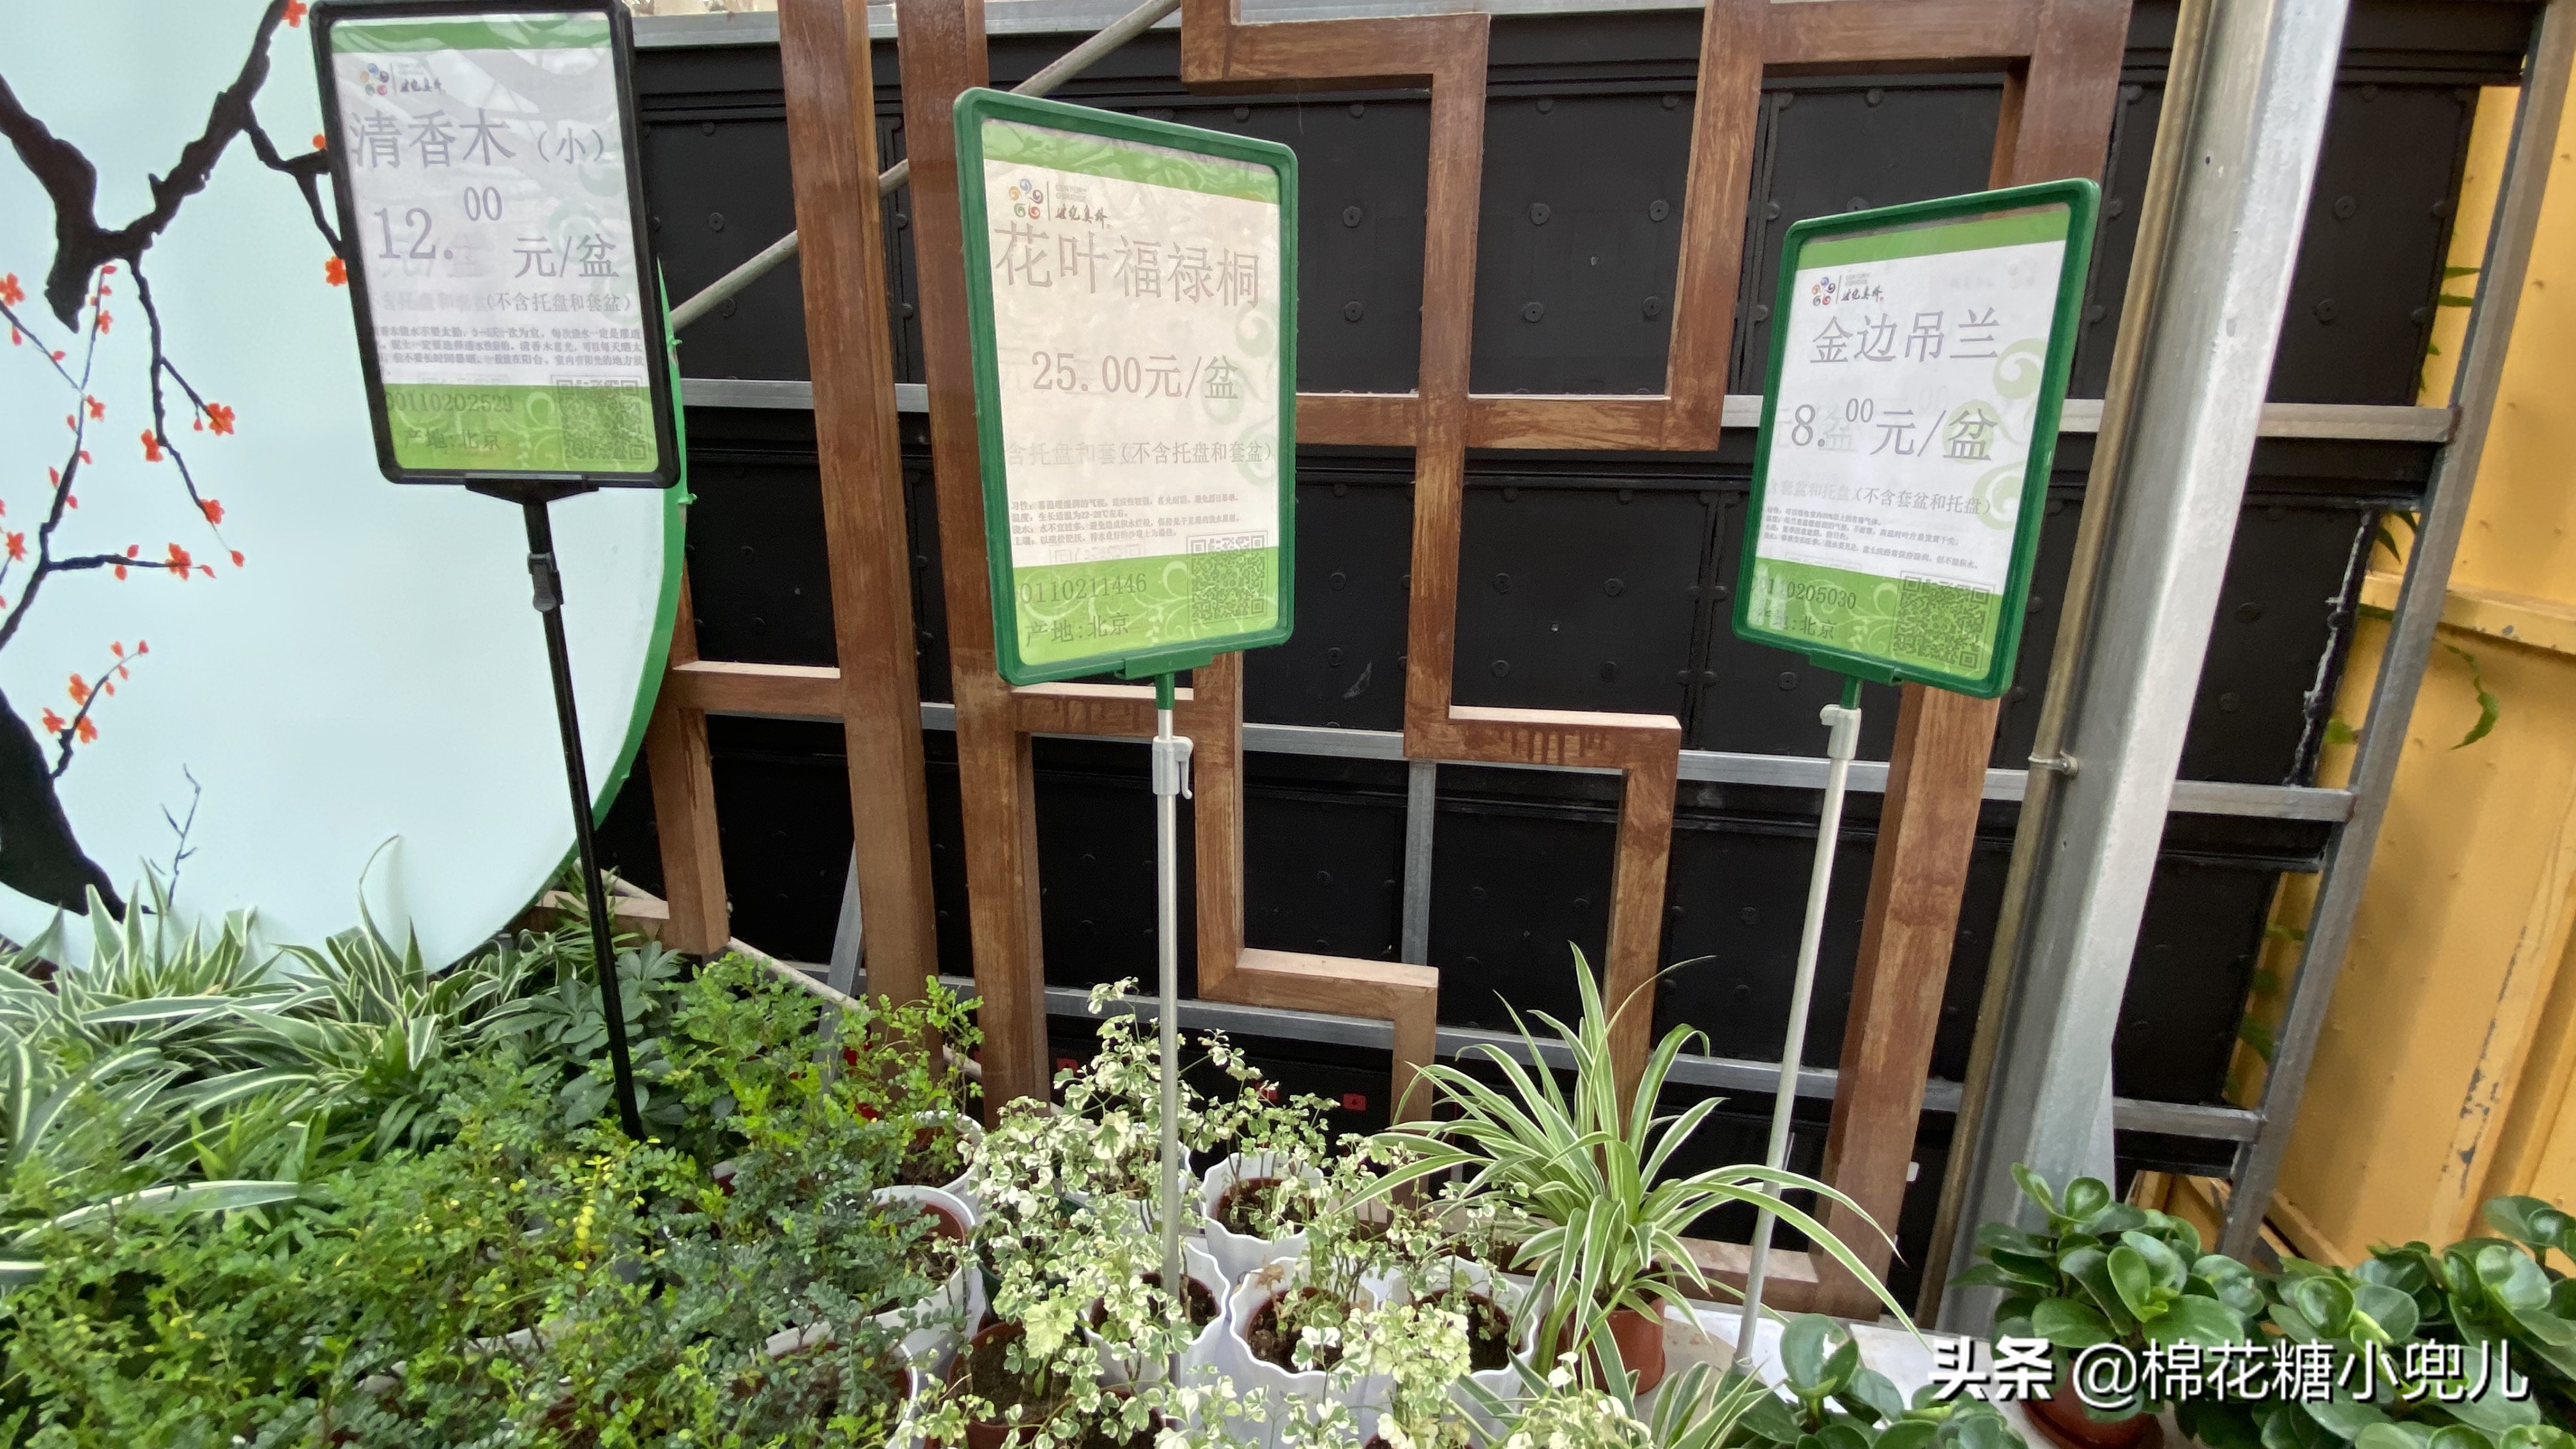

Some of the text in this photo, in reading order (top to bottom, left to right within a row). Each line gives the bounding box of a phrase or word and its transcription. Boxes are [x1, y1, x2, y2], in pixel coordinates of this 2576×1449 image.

[994, 220, 1259, 307] 花叶福禄桐
[1809, 307, 1999, 363] 金边吊兰
[1031, 351, 1239, 400] 25.00元/盆
[1020, 573, 1147, 604] 0110211446
